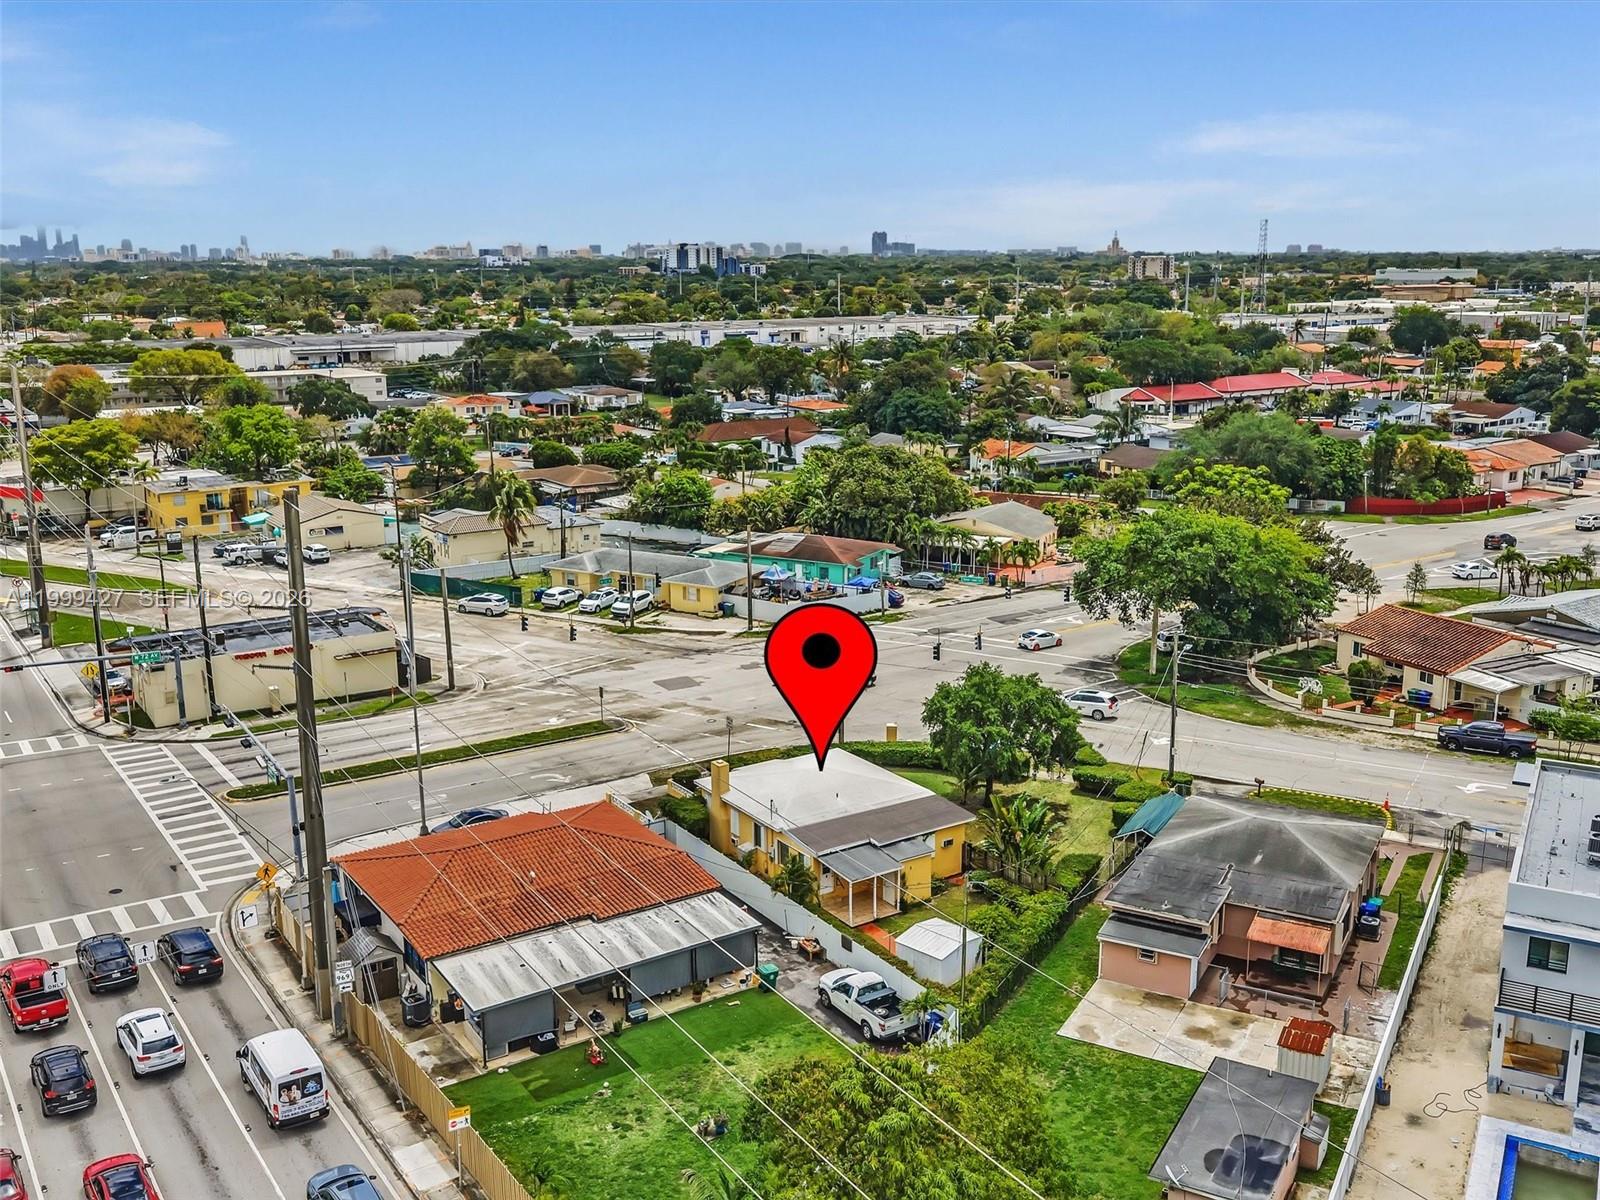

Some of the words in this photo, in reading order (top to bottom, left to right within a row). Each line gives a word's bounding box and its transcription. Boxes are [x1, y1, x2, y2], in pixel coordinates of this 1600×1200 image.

[138, 955, 153, 964] ONLY
[336, 973, 350, 981] 969
[47, 982, 64, 990] ONLY
